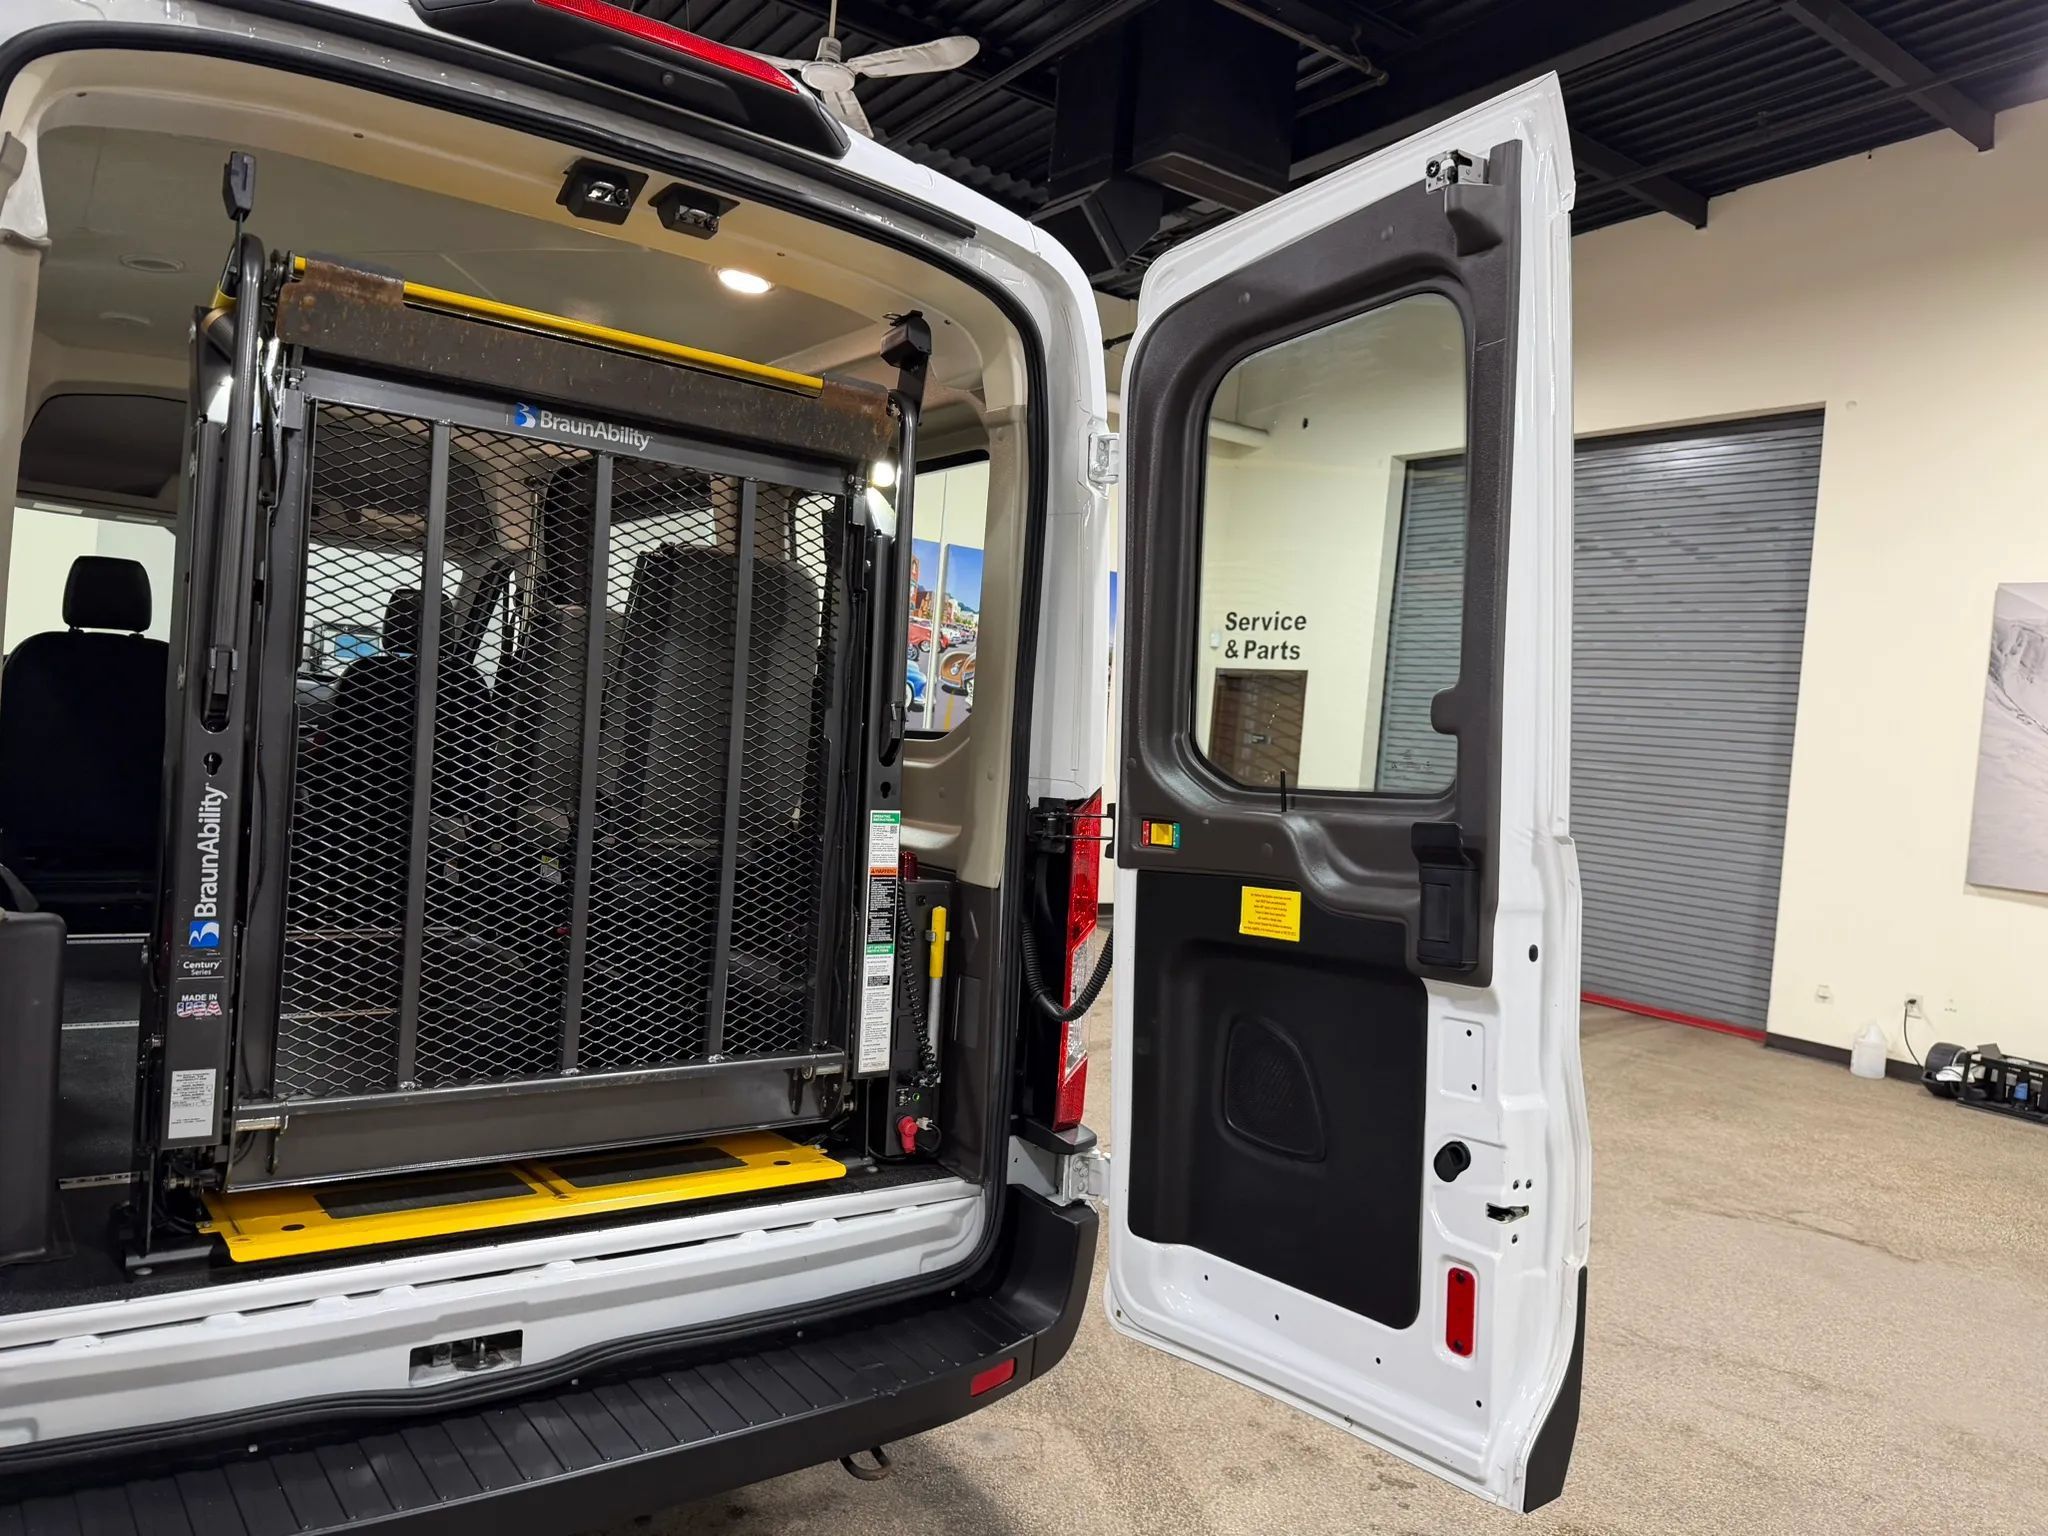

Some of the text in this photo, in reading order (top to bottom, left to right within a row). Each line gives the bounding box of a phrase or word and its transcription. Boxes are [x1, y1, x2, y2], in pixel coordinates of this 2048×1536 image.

[540, 409, 650, 452] BraunAbility
[1225, 611, 1307, 631] Service
[1224, 639, 1301, 660] & Parts
[193, 784, 229, 918] BraunAbility
[183, 960, 220, 970] Century
[191, 968, 212, 976] Series
[181, 993, 218, 1002] MADE IN
[176, 1001, 223, 1018] USA
